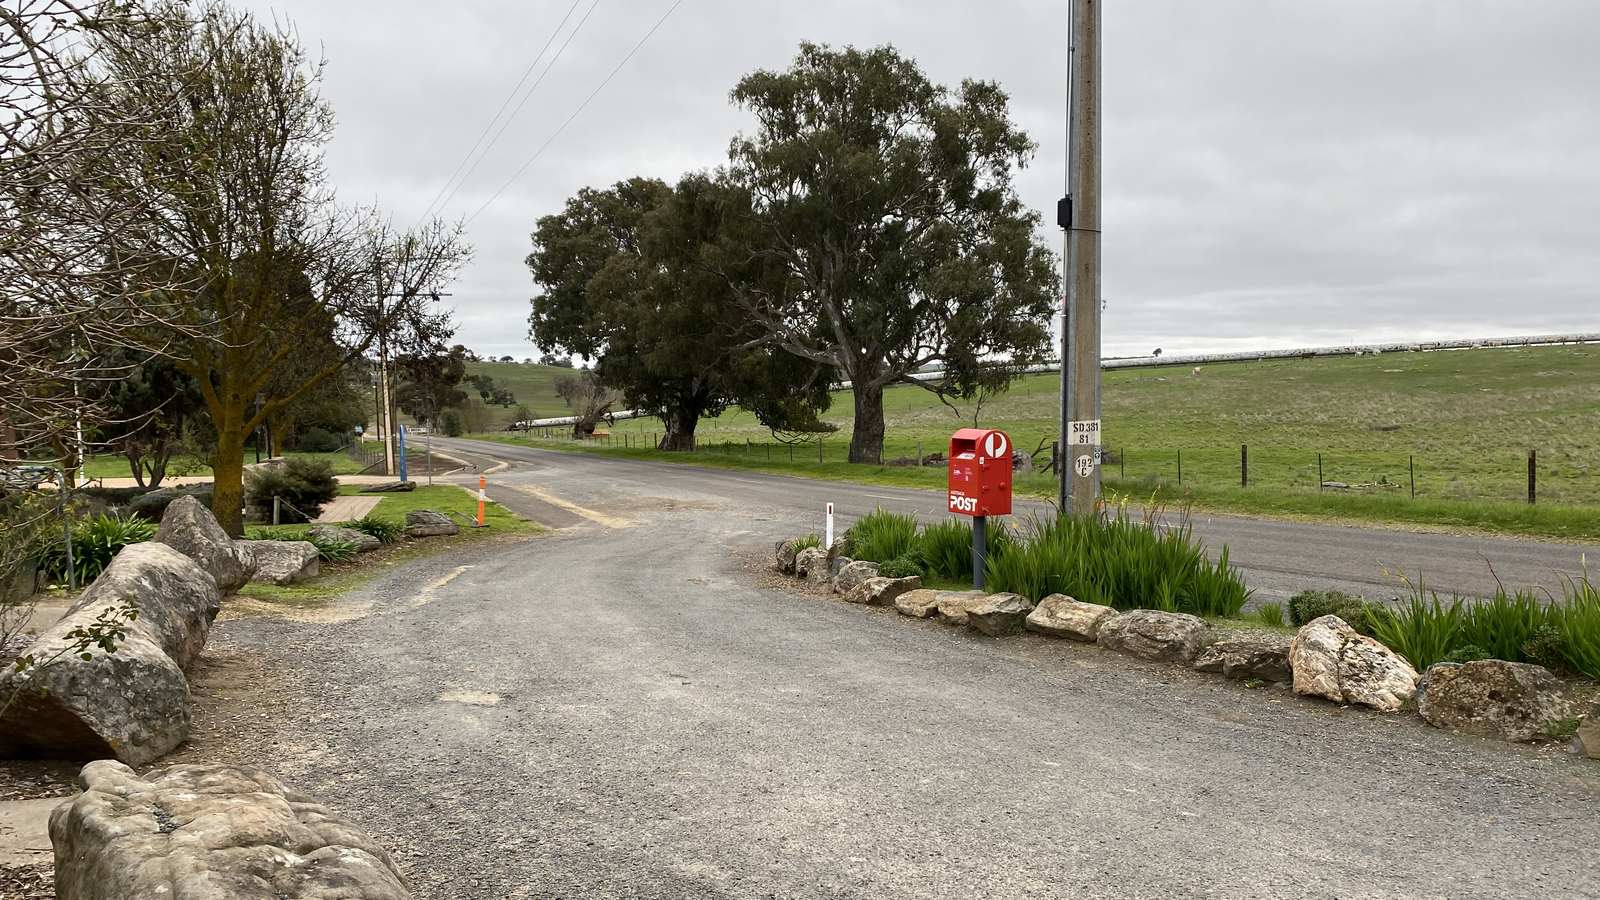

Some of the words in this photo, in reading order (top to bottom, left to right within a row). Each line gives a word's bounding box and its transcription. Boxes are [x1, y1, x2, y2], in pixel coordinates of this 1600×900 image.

[1079, 434, 1088, 443] 81
[1077, 459, 1092, 467] 192
[950, 495, 977, 511] POST
